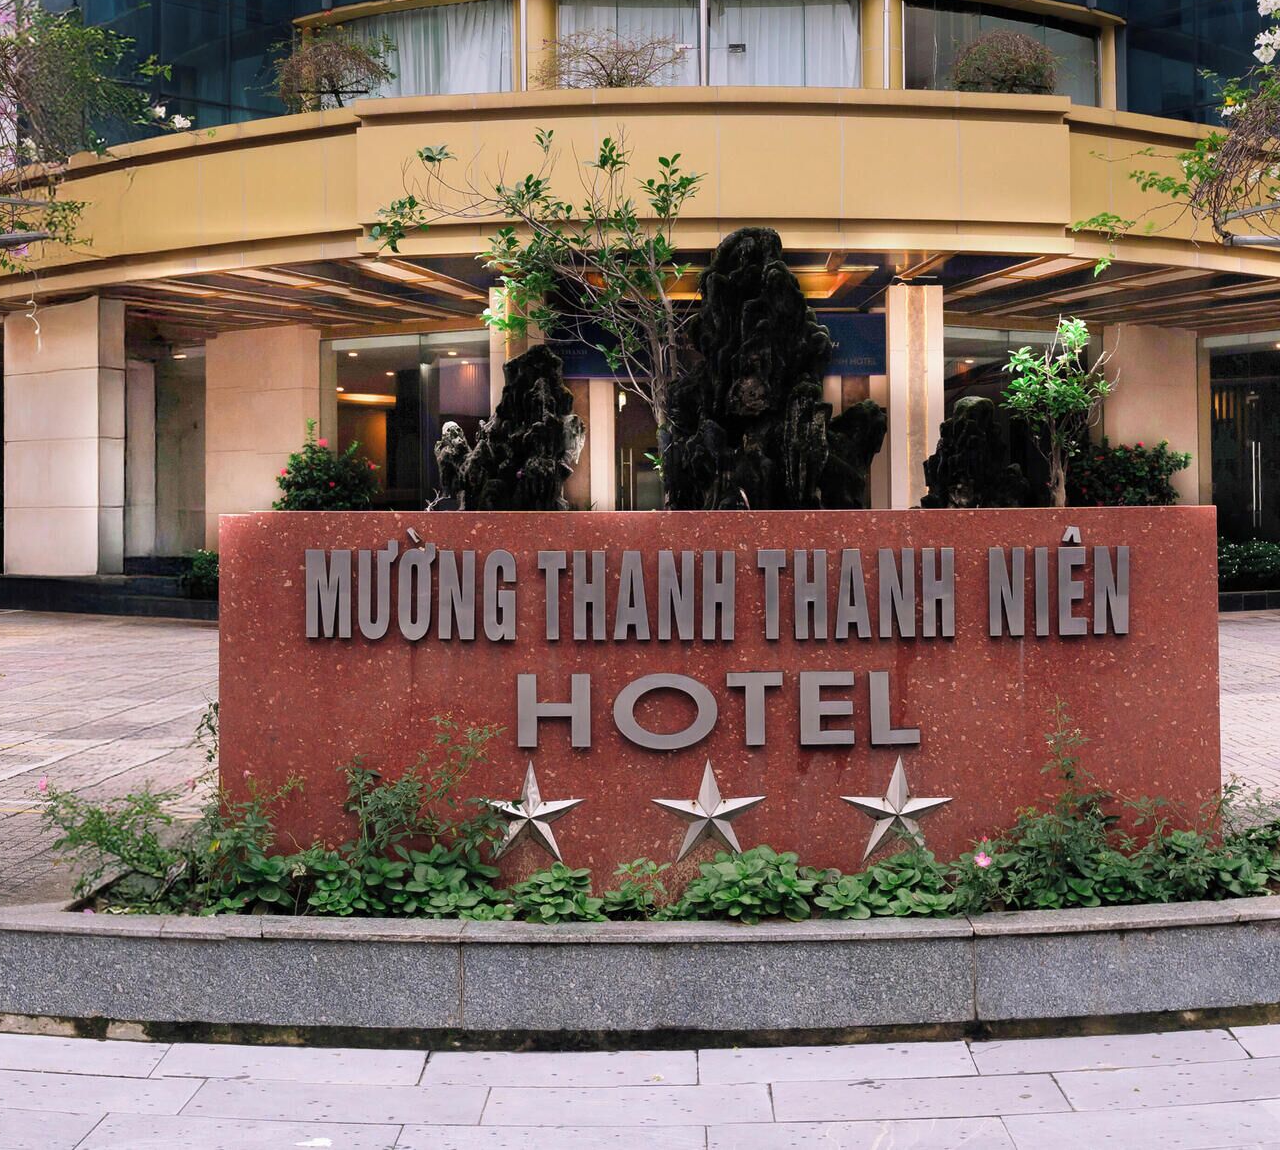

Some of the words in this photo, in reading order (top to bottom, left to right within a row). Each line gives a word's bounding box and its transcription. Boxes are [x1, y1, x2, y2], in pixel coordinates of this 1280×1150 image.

[305, 527, 517, 641] MƯỜNG
[537, 549, 736, 641] THANH
[756, 547, 955, 640] THANH
[988, 526, 1130, 638] NIÊN
[518, 669, 921, 751] HOTEL
